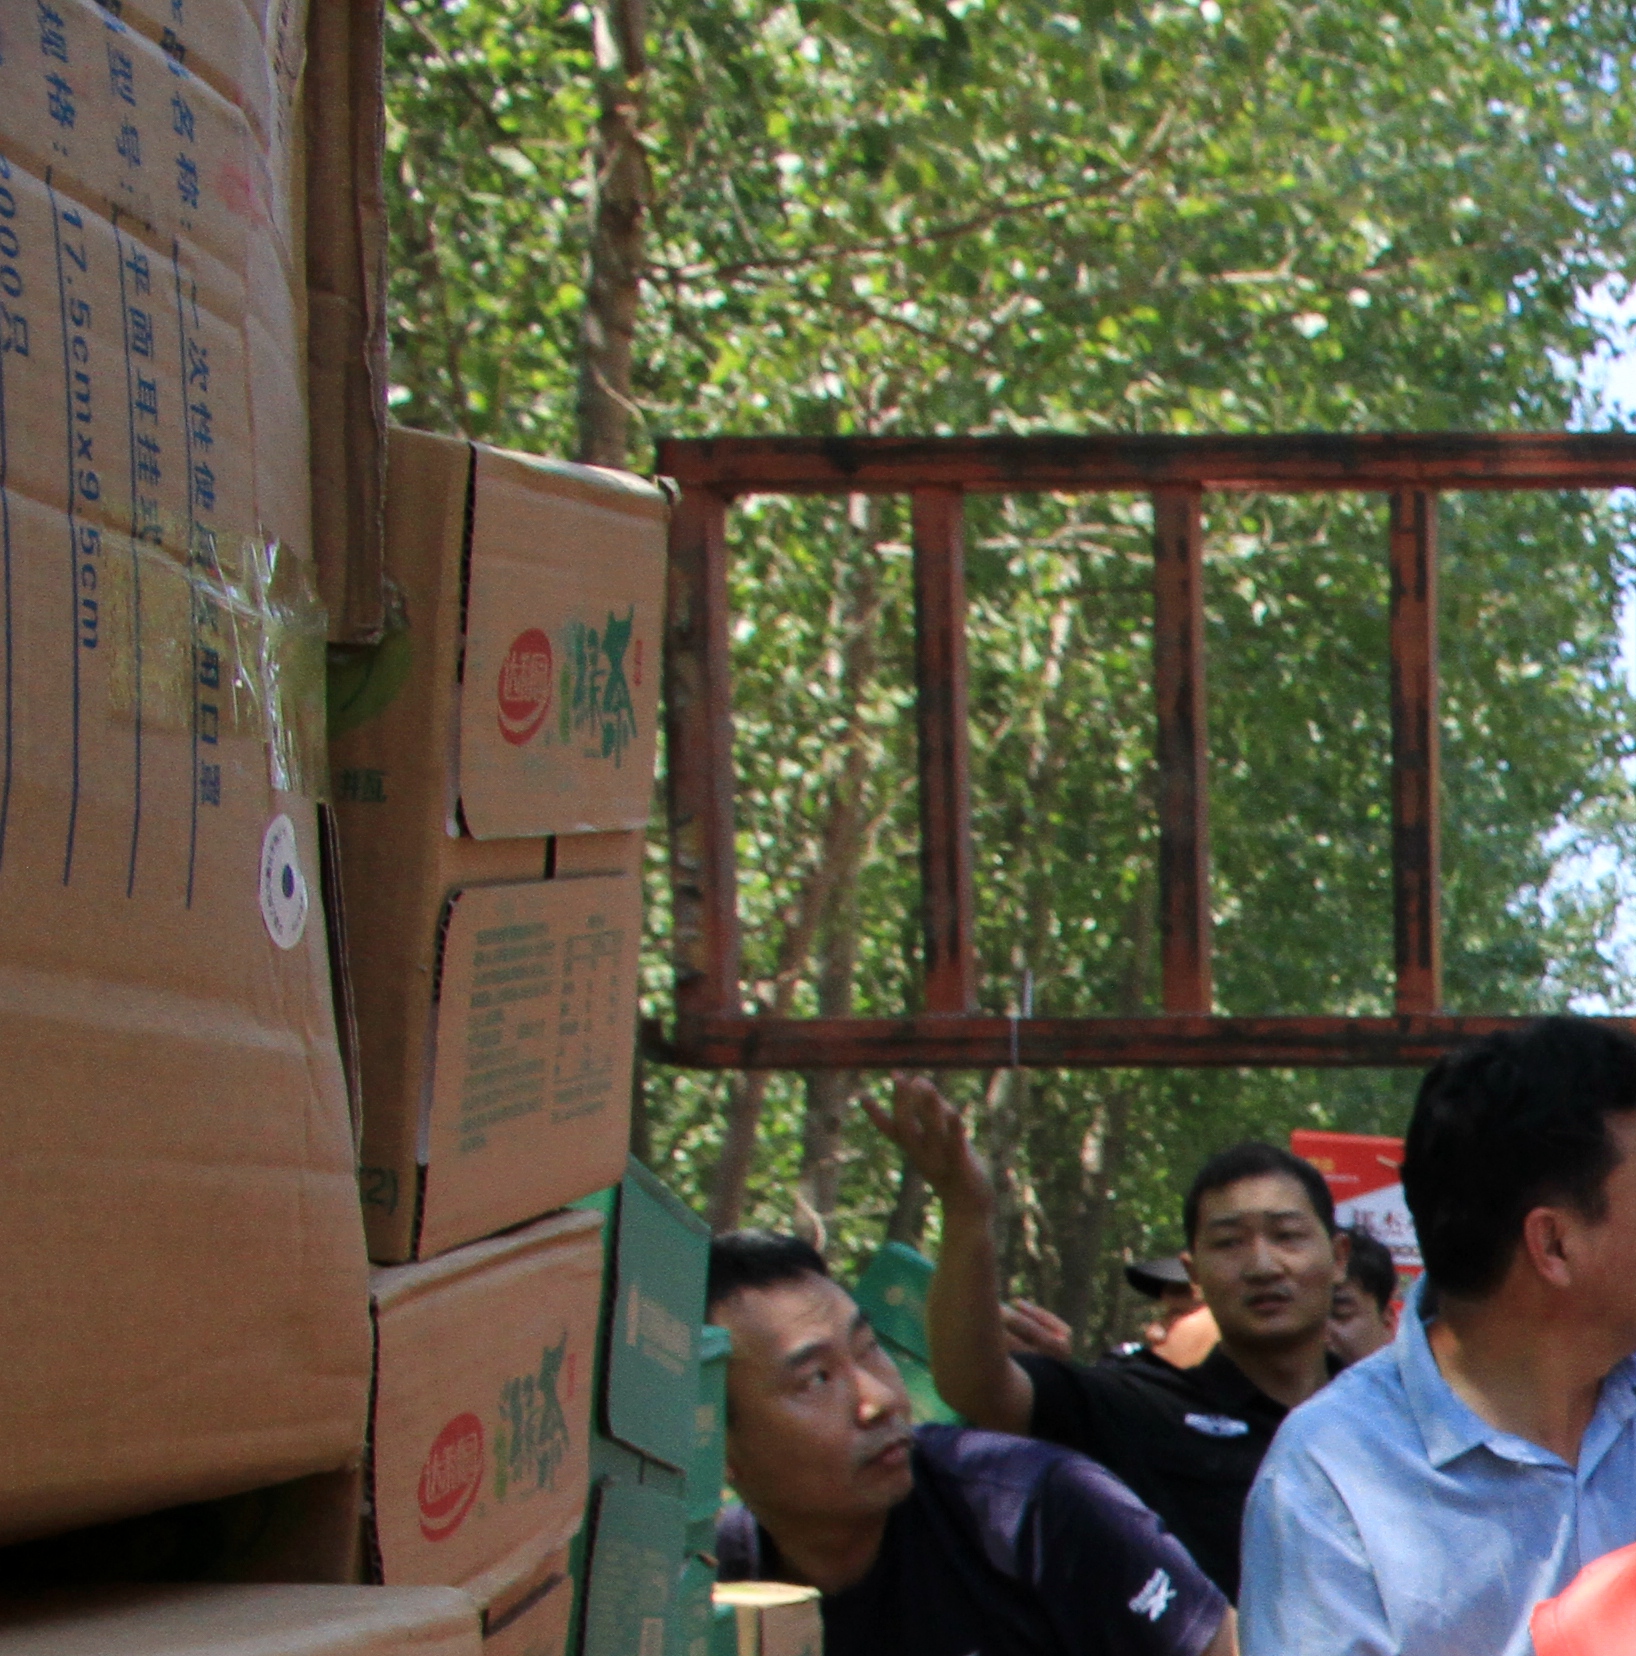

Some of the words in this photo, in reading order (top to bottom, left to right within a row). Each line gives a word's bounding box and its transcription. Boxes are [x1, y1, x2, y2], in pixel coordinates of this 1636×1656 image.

[128, 244, 164, 546] 平面耳挂式
